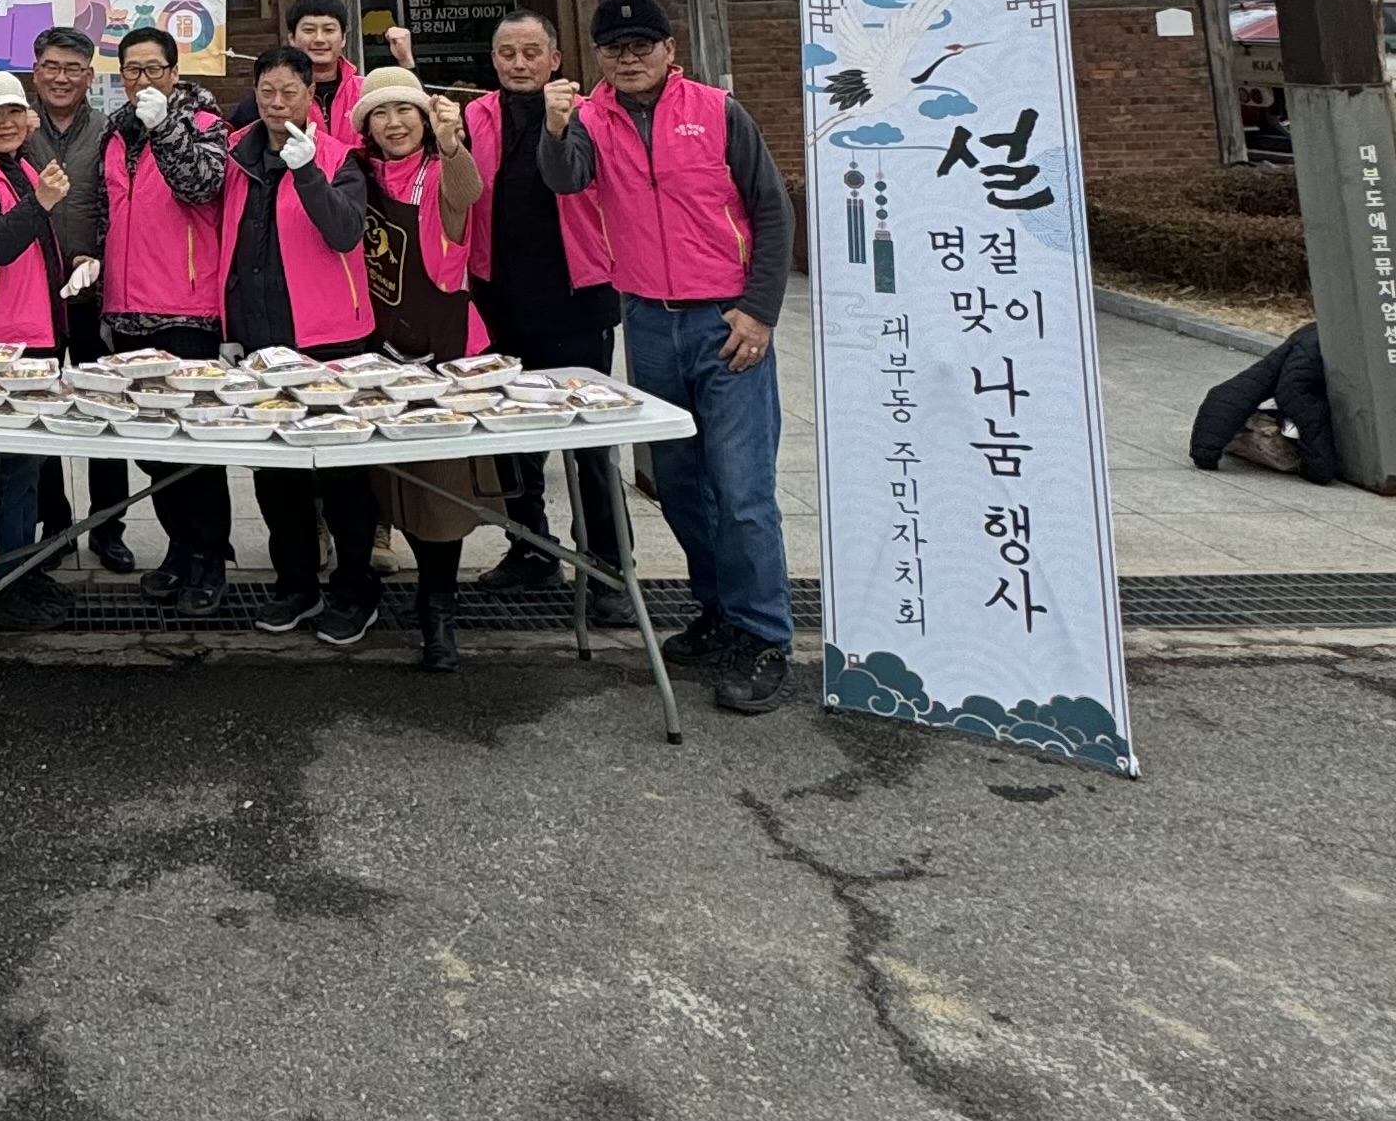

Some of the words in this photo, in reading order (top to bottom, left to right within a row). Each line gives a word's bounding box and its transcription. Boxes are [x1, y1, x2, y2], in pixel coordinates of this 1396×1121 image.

[435, 7, 469, 20] 시간의
[471, 6, 507, 18] 이야기
[1252, 60, 1274, 71] KIA
[936, 108, 1055, 210] 설
[928, 225, 1018, 274] 명절
[950, 286, 1044, 339] 맞이
[880, 315, 918, 423] 대부동
[969, 356, 1033, 477] 나눔
[885, 442, 927, 637] 주민자치회
[984, 504, 1047, 634] 행사
